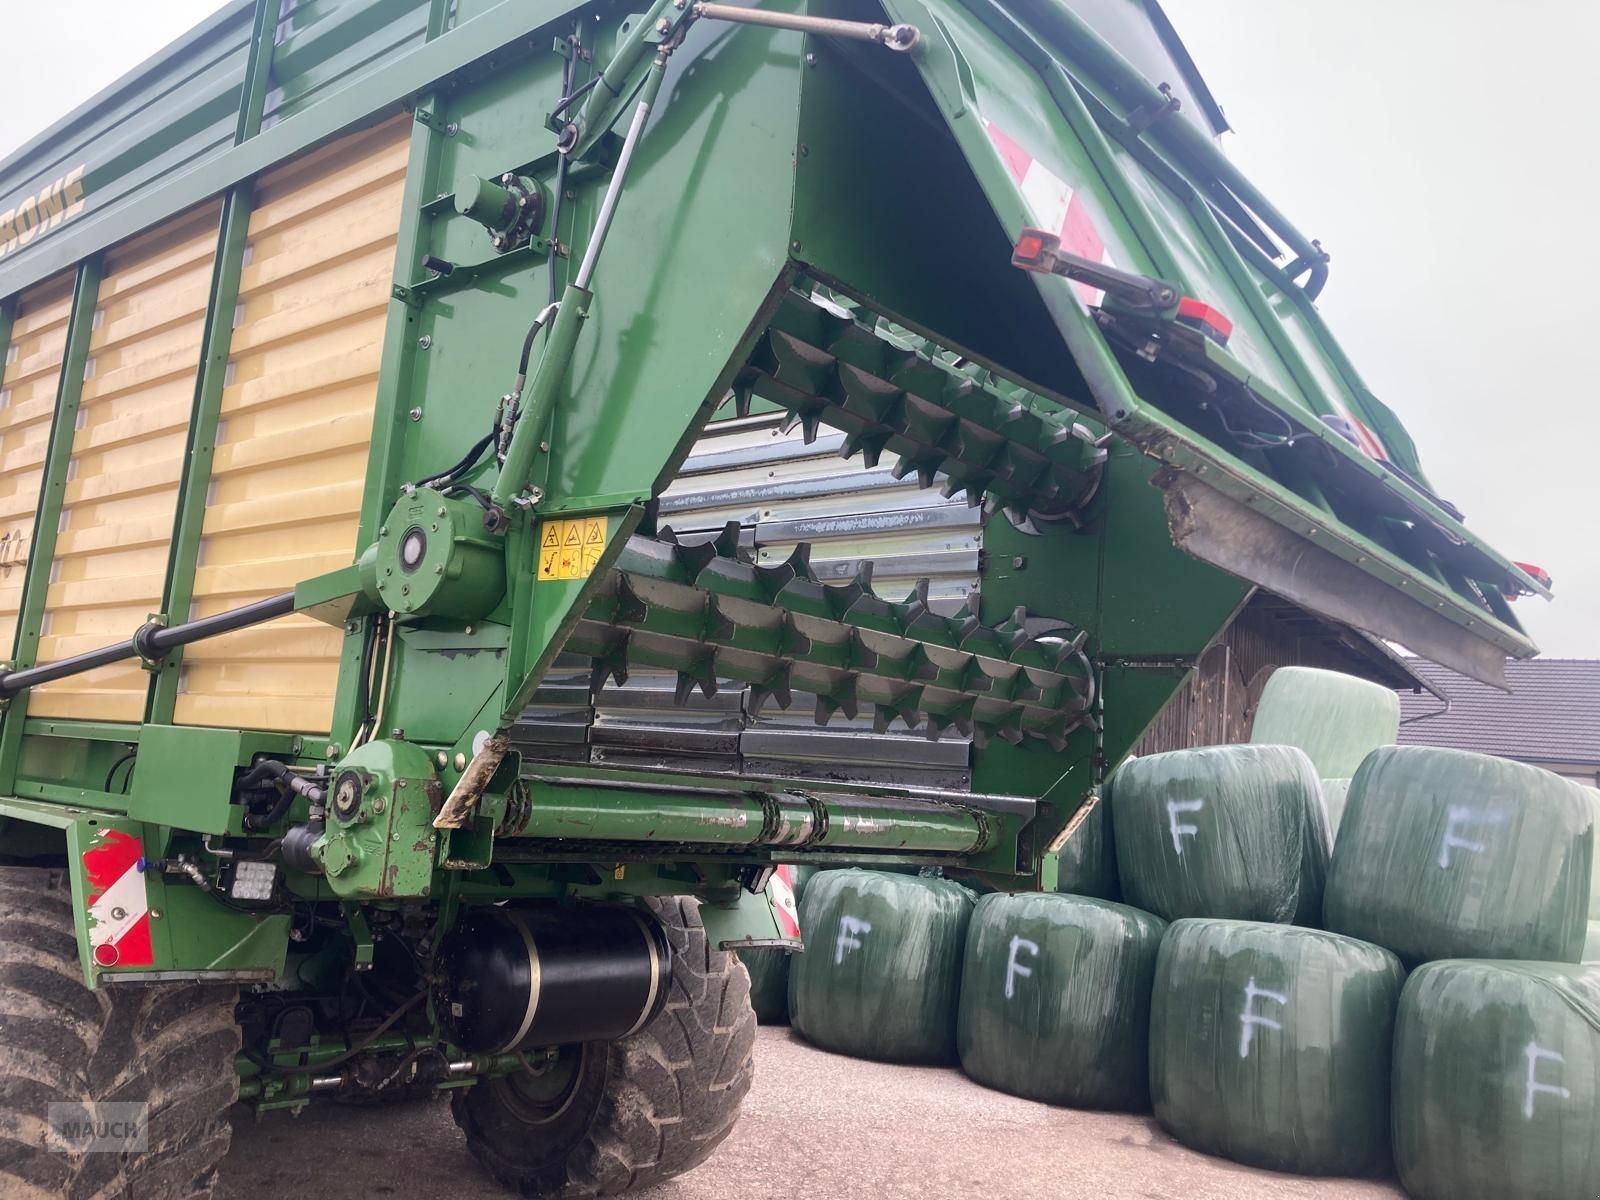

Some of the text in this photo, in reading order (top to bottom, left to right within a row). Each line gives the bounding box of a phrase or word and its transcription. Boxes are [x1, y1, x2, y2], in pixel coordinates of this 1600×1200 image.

[1167, 799, 1204, 857] F
[1438, 804, 1506, 870] F
[836, 915, 872, 965] F
[1004, 935, 1039, 1000] F
[1239, 976, 1289, 1060] F
[1523, 1041, 1571, 1121] F
